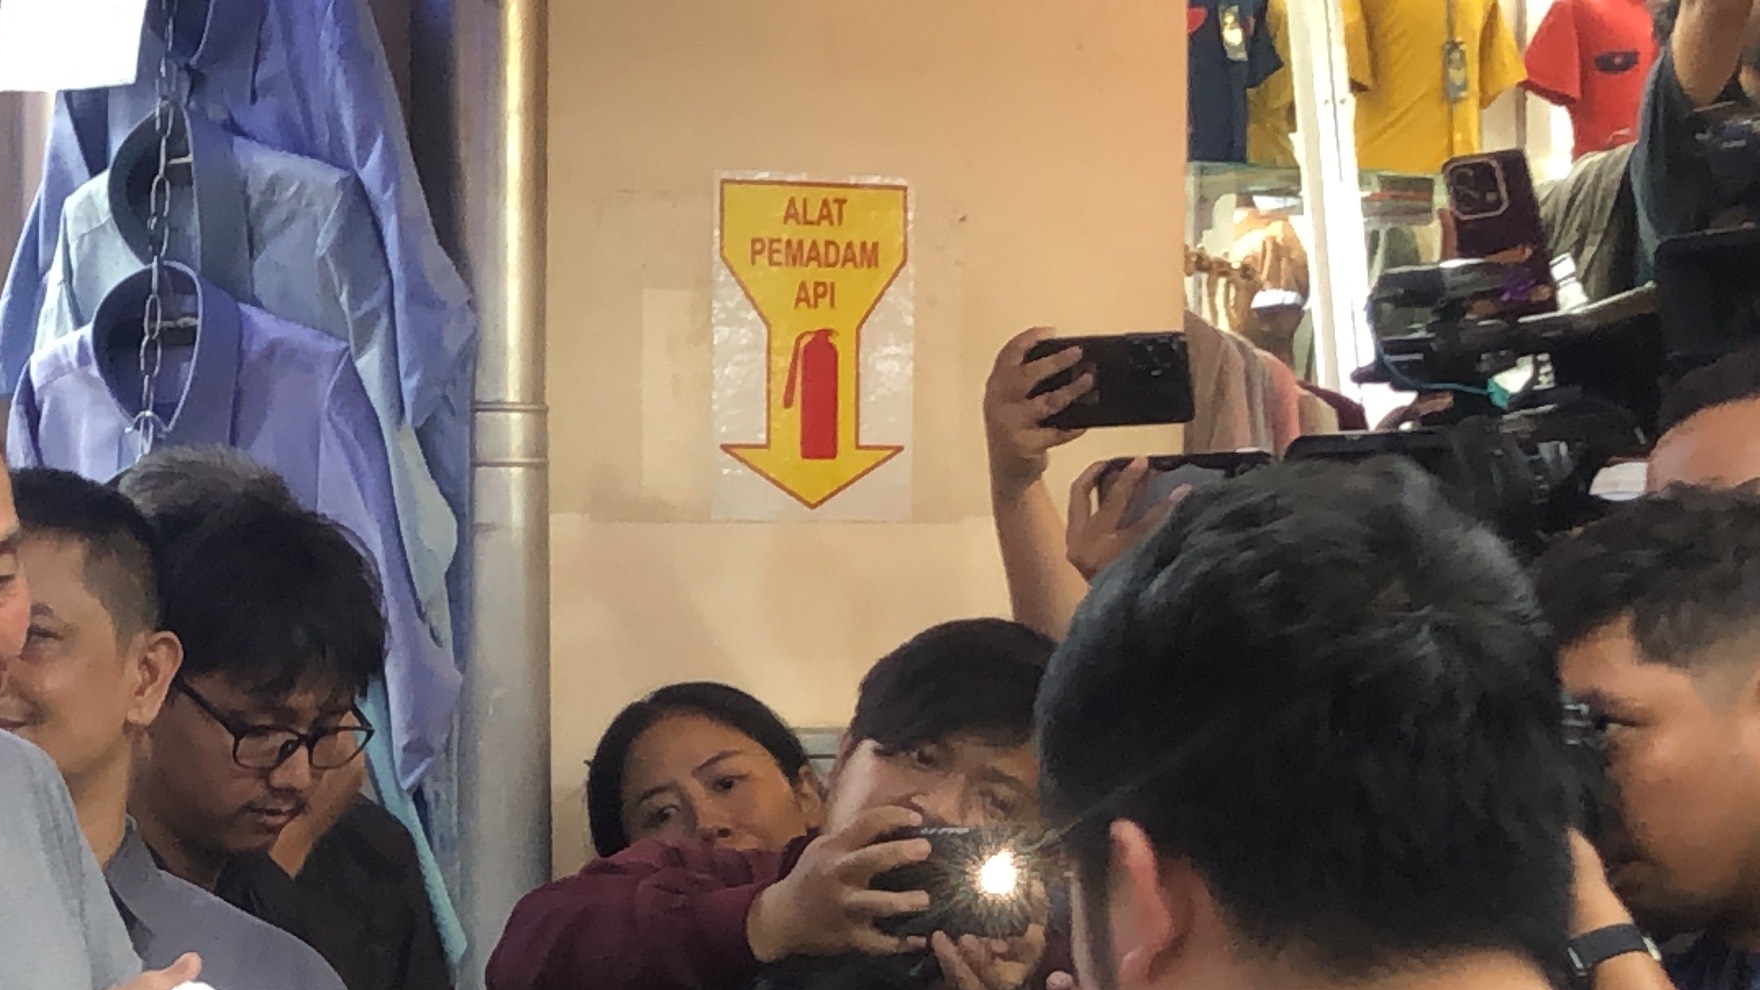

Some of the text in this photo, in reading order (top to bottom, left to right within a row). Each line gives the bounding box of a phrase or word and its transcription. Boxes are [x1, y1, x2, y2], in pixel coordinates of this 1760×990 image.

[783, 196, 848, 226] ALAT
[750, 237, 880, 269] PEMADAM
[794, 280, 836, 310] API
